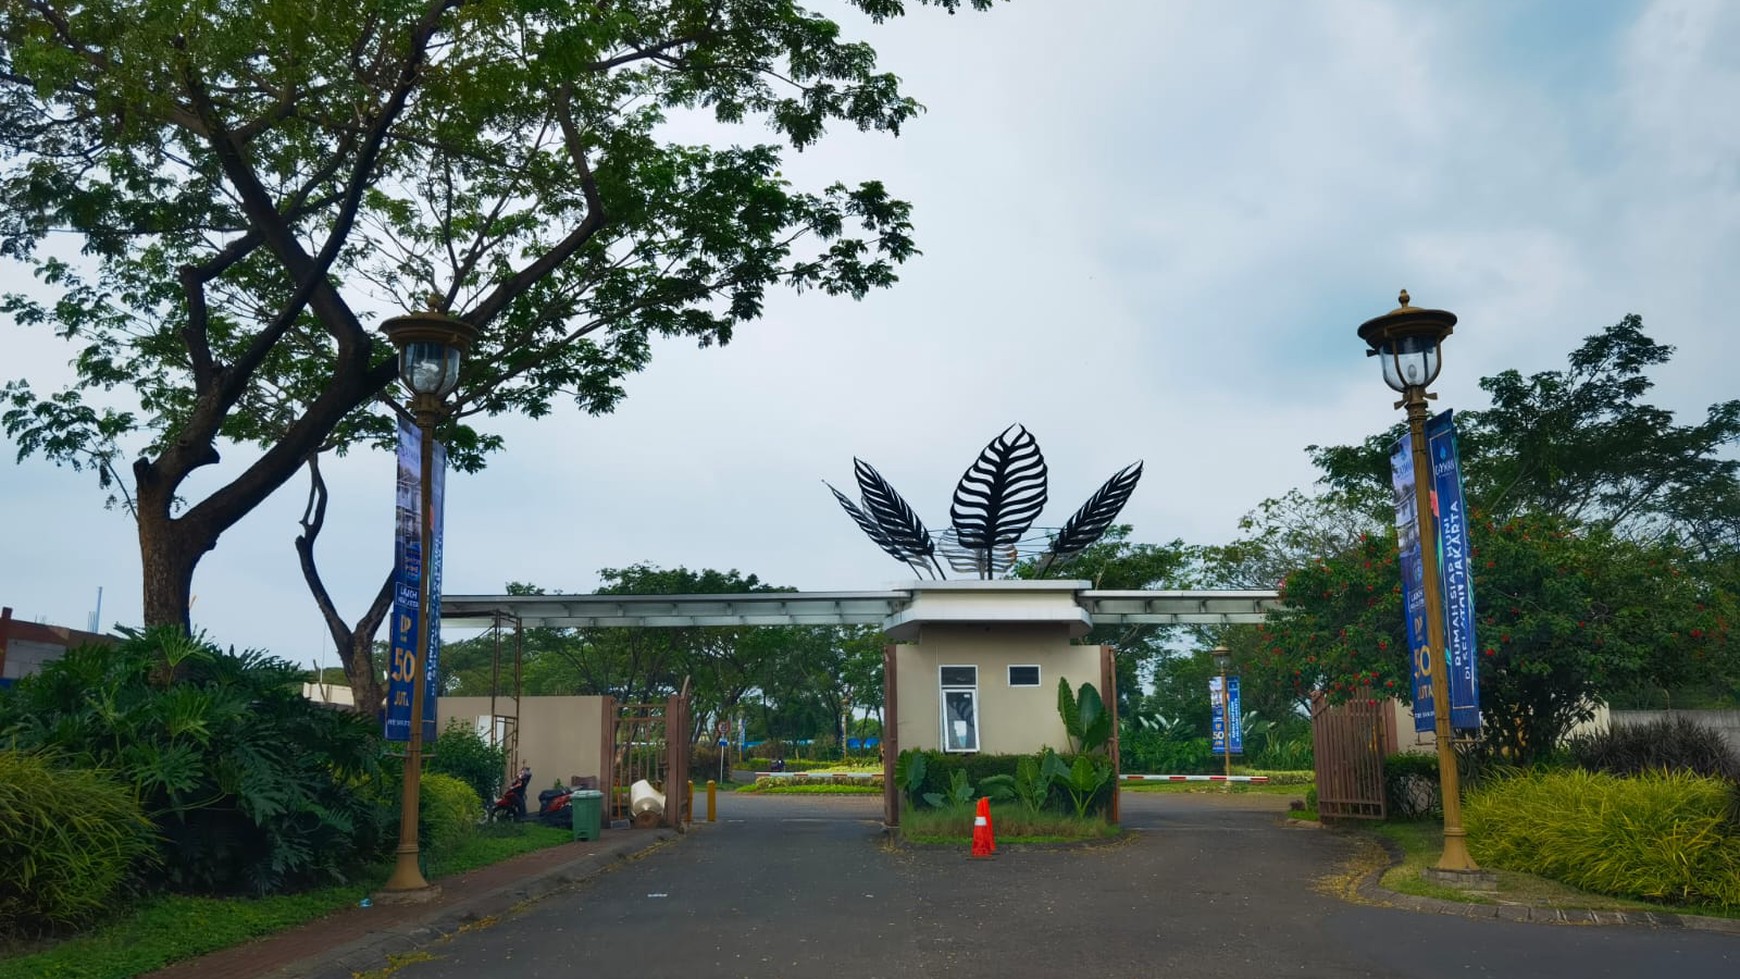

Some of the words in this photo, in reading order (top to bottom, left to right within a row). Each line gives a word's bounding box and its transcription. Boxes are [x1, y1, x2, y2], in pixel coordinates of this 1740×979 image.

[1444, 518, 1453, 557] HUNI
[1450, 500, 1464, 577] JAKARTA
[1448, 562, 1457, 599] SIAP
[1451, 605, 1462, 666] RUMAH
[391, 647, 415, 683] 50
[1414, 645, 1431, 679] 50
[1465, 666, 1471, 680] DI
[1213, 731, 1224, 740] 50
